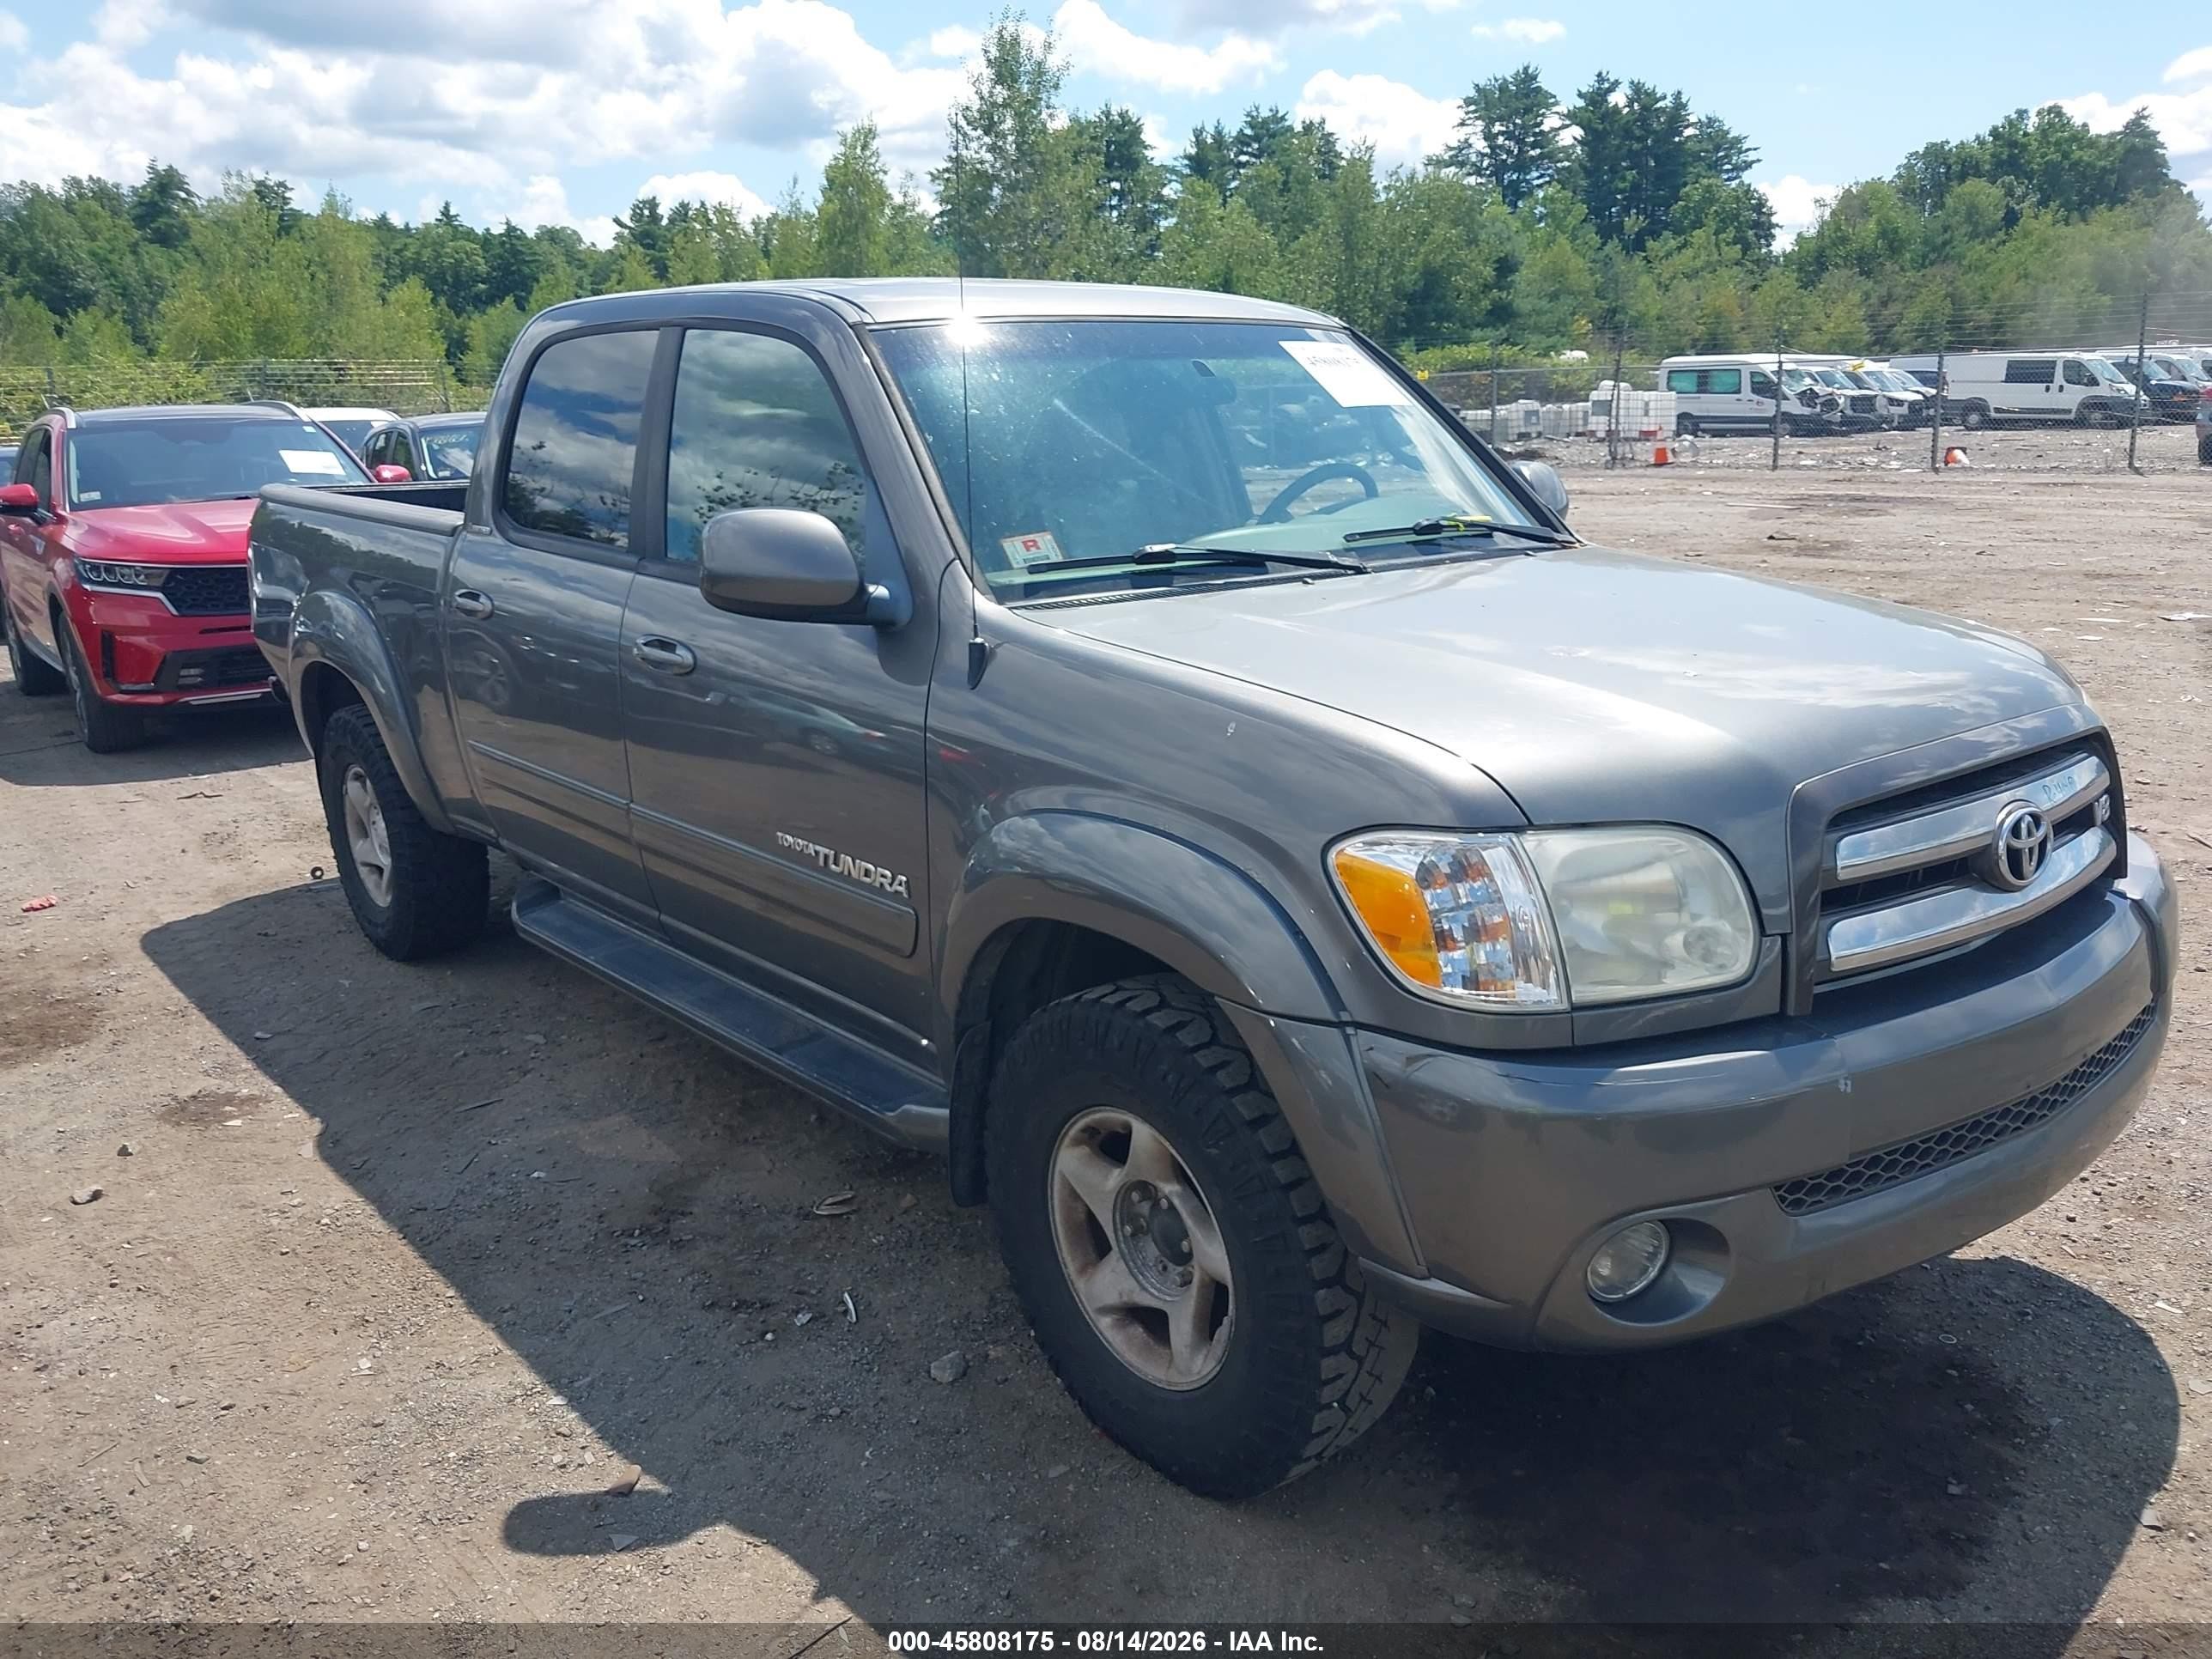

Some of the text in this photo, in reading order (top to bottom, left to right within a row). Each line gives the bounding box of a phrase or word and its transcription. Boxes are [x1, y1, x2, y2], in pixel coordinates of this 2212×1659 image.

[2094, 794, 2111, 826] V8
[776, 831, 909, 898] TOYOTA TUNDRA
